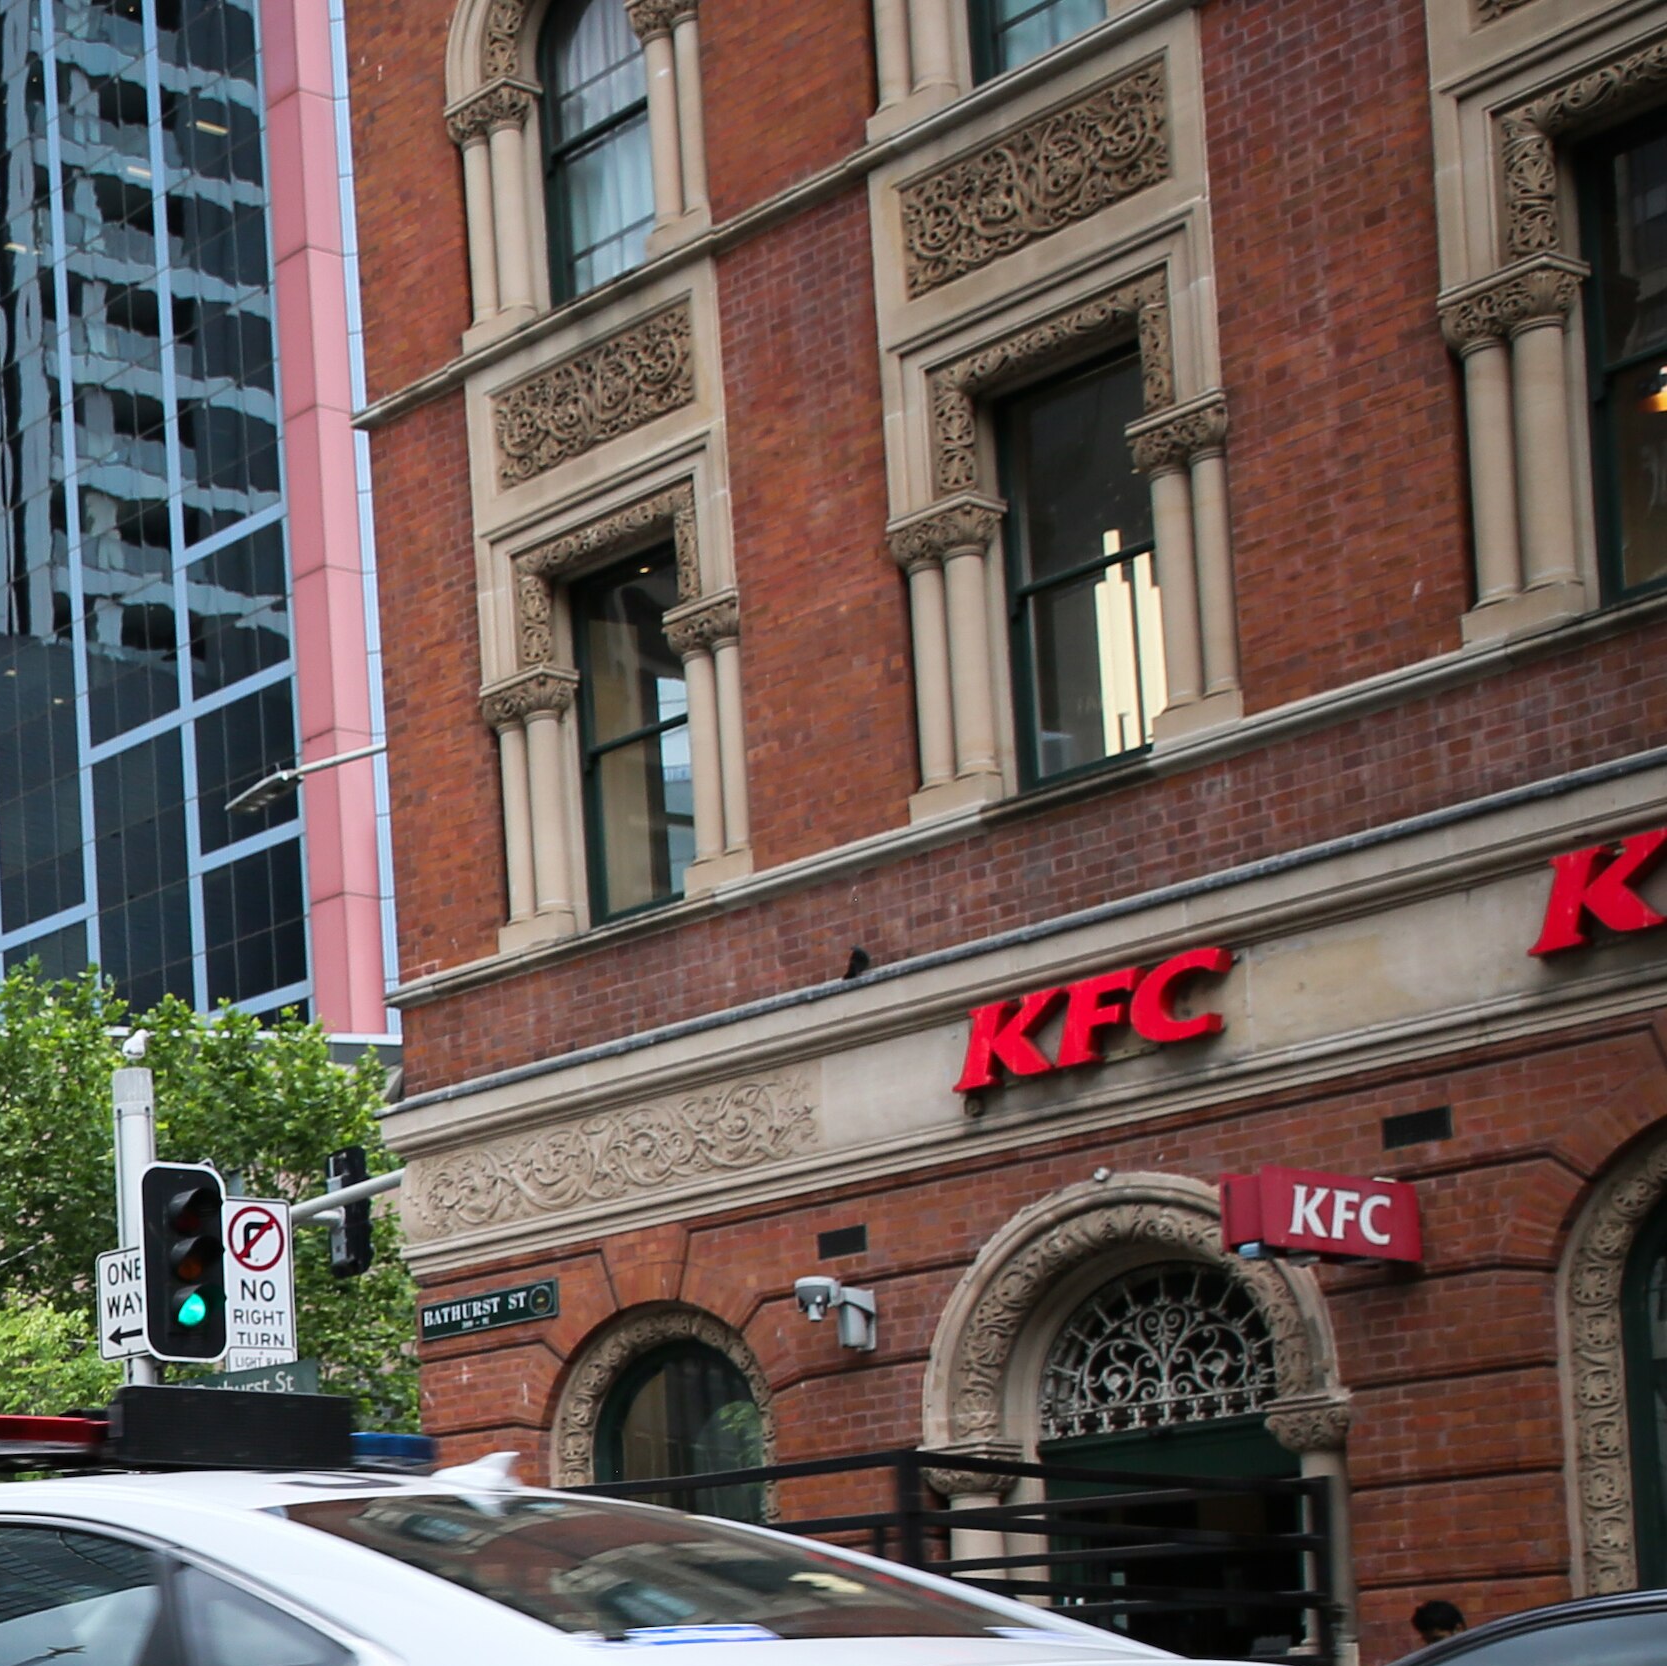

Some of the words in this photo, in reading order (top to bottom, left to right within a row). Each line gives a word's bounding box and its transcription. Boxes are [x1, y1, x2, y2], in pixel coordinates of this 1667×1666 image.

[953, 946, 1233, 1093] KFC
[1288, 1183, 1393, 1246] KFC
[107, 1258, 141, 1286] ONE
[241, 1279, 275, 1302] NO
[107, 1290, 143, 1319] WAY
[233, 1308, 286, 1326] RIGHT
[424, 1297, 500, 1327] BATHURST
[508, 1291, 527, 1310] ST
[237, 1332, 285, 1346] TURN
[235, 1356, 262, 1368] LIGHT
[275, 1371, 295, 1393] St
